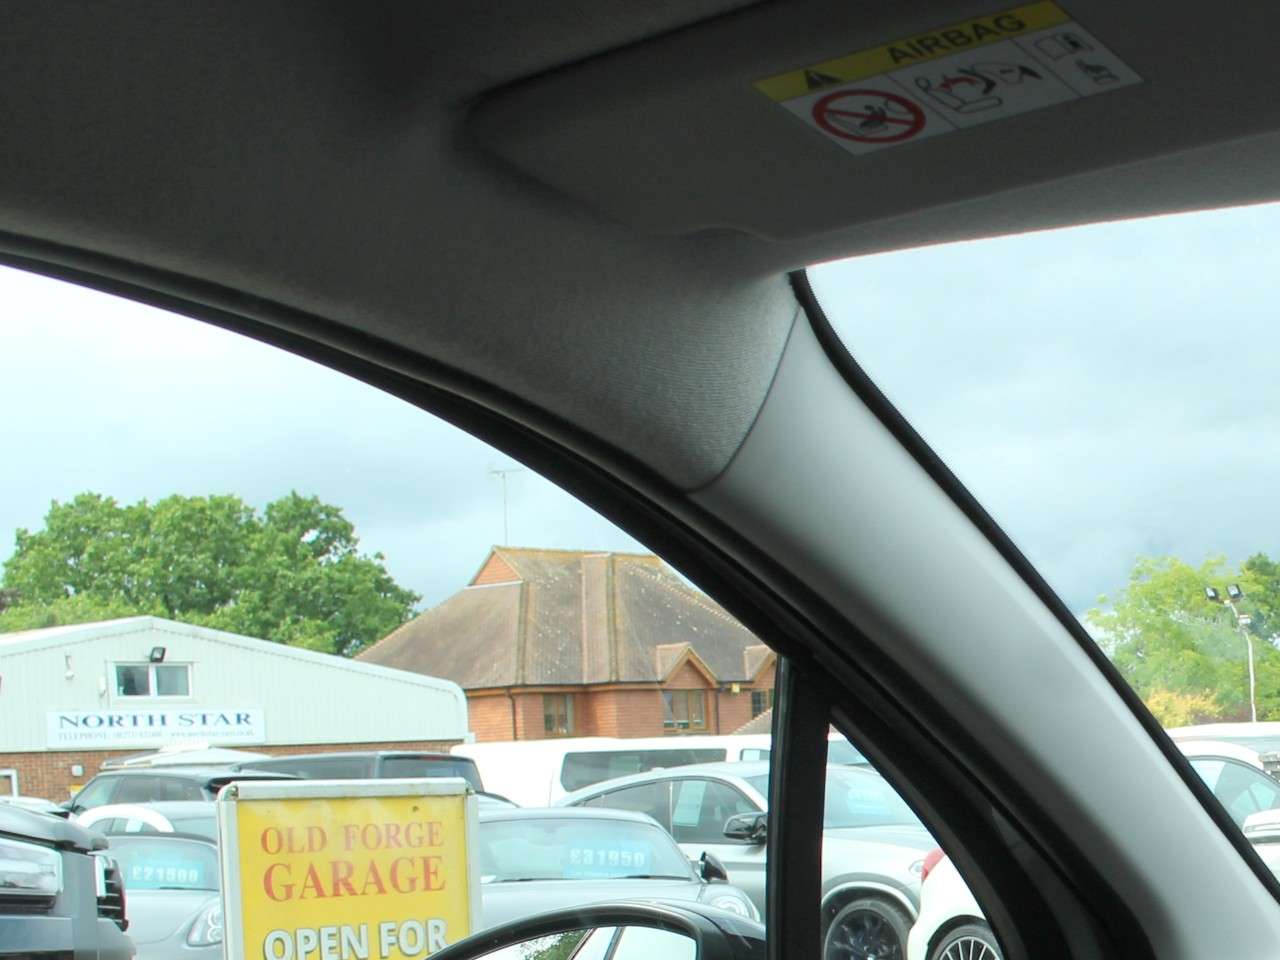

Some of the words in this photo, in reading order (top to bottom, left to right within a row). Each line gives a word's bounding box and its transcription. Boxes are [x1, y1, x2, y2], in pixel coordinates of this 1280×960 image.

[886, 14, 1027, 64] AIRBAG
[58, 712, 167, 729] NORTH
[178, 711, 252, 727] STAR
[260, 825, 327, 855] OLD
[344, 820, 444, 851] FORGE
[262, 855, 446, 902] GARAGE
[379, 917, 449, 960] FOR
